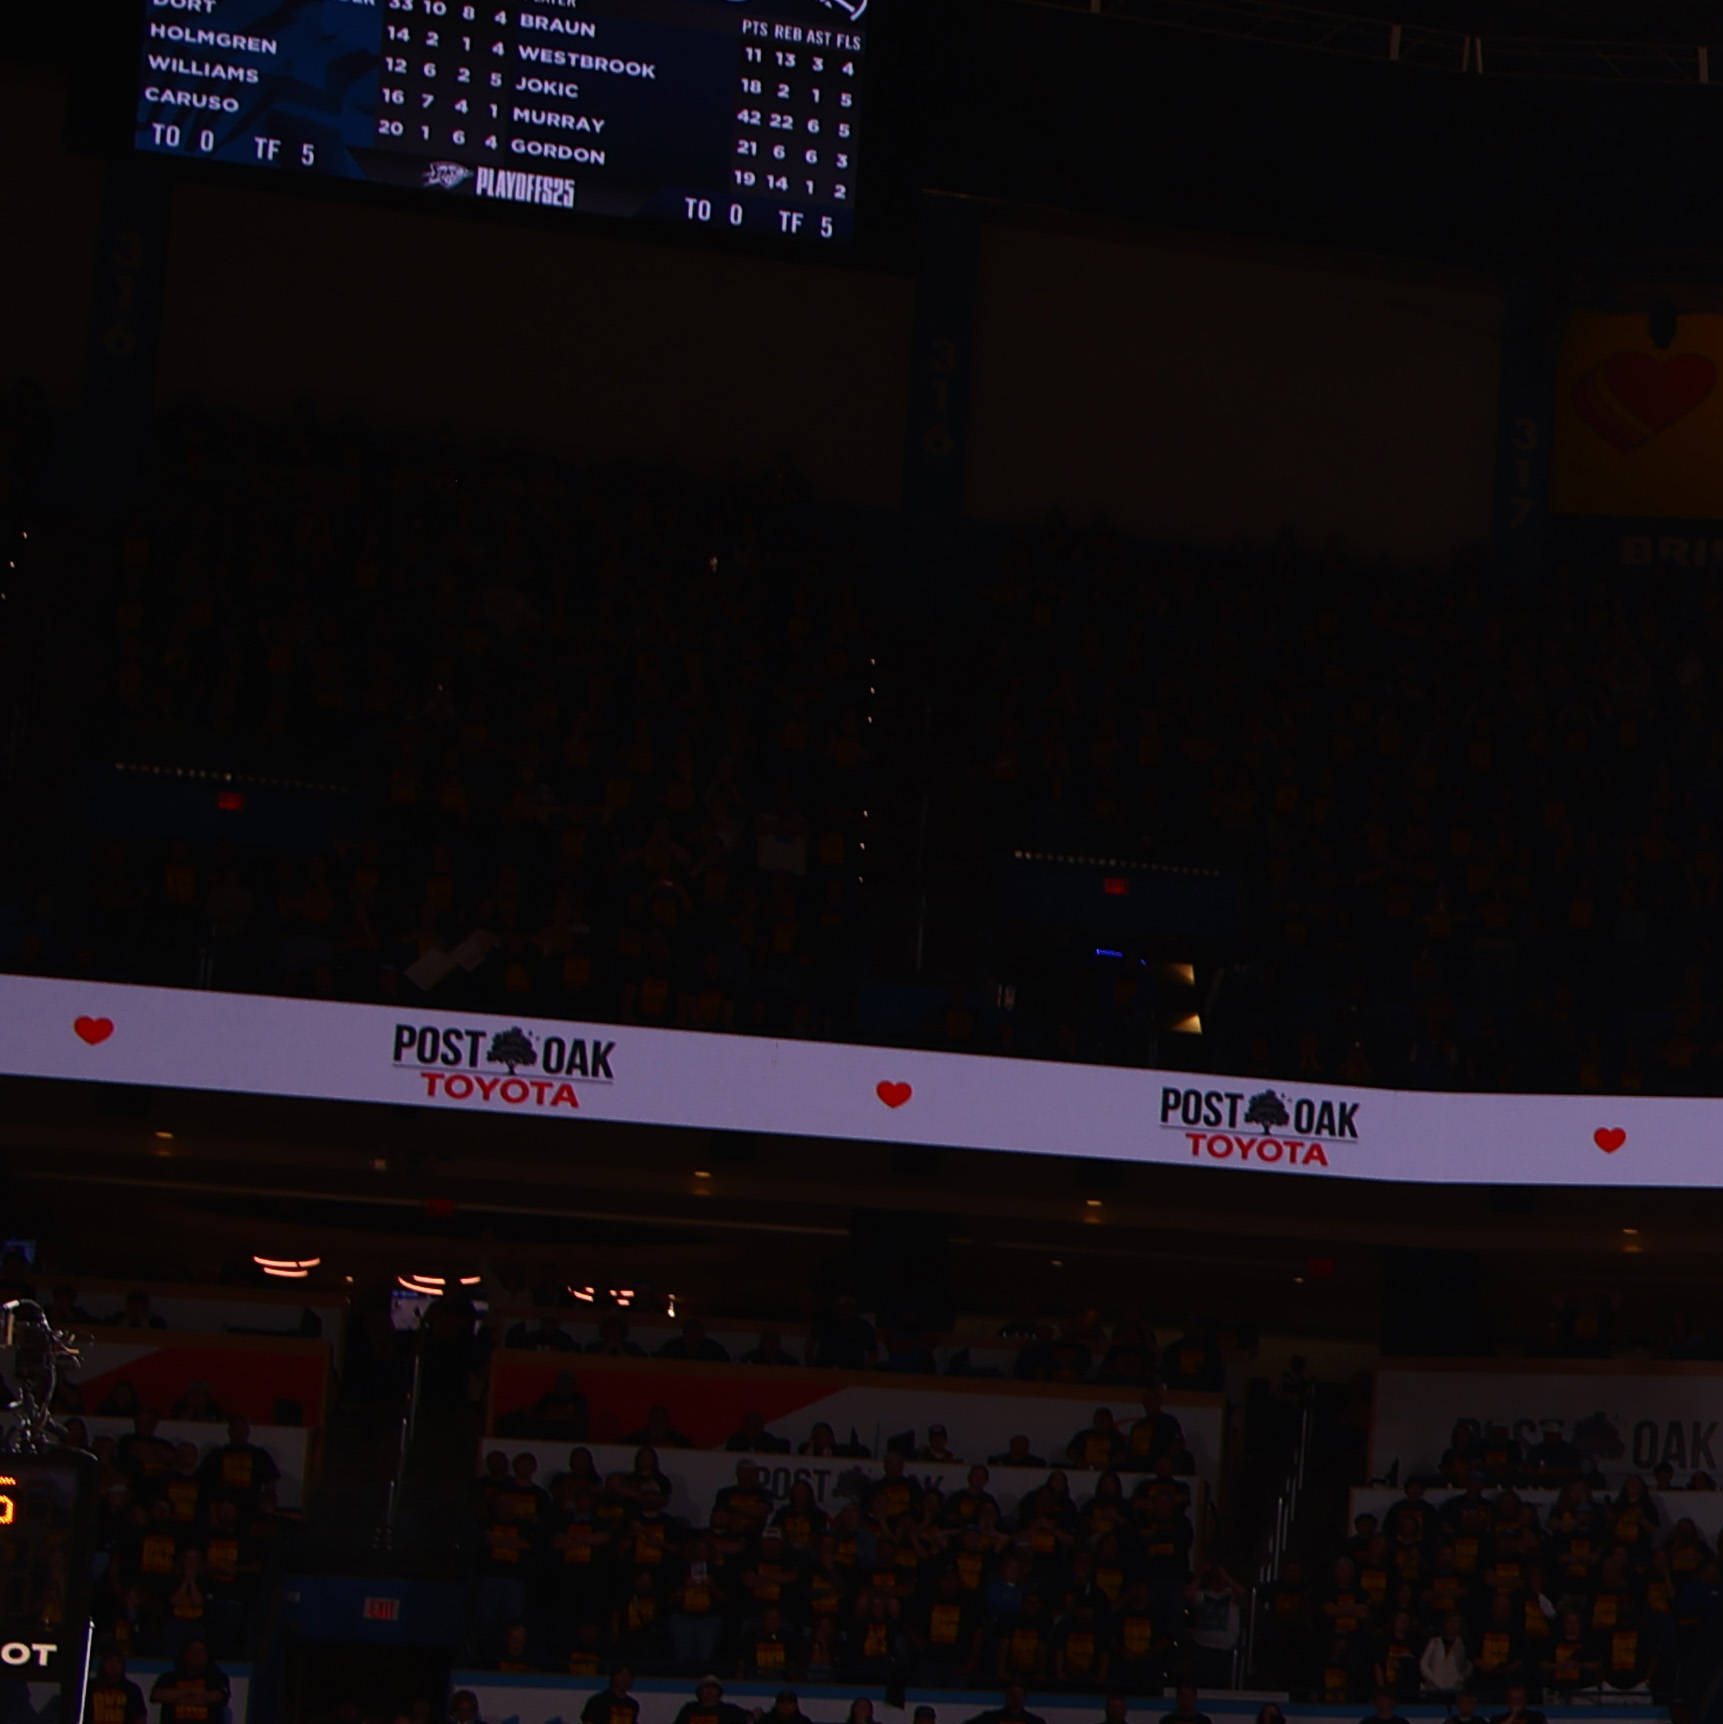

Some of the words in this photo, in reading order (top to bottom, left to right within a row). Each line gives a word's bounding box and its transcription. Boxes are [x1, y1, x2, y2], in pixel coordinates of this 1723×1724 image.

[424, 1, 447, 15] 10
[462, 6, 475, 20] 8
[494, 10, 507, 25] 4
[742, 19, 768, 37] PTS
[774, 24, 802, 42] REB
[807, 29, 831, 47] AST
[837, 34, 861, 50] FLS
[150, 23, 277, 54] HOLMGREN
[385, 56, 407, 74] 12
[424, 62, 436, 77] 6
[457, 68, 470, 83] 2
[490, 73, 502, 87] 5
[387, 25, 410, 42] 14
[425, 31, 438, 47] 2
[462, 37, 471, 51] 1
[492, 41, 505, 56] 4
[520, 13, 596, 38] BRAUN
[745, 47, 762, 63] 11
[776, 52, 796, 68] 13
[812, 57, 824, 72] 3
[842, 62, 854, 76] 4
[148, 54, 259, 84] WILLIAMS
[382, 88, 404, 104] 16
[422, 94, 434, 109] 7
[455, 99, 468, 114] 4
[490, 103, 498, 119] 1
[518, 45, 656, 79] WESTBROOK
[741, 78, 762, 94] 18
[777, 84, 789, 99] 2
[812, 88, 820, 103] 1
[841, 93, 852, 107] 5
[145, 87, 239, 112] CARUSO
[378, 119, 404, 136] 20
[422, 125, 429, 141] 1
[453, 131, 465, 145] 6
[485, 135, 498, 150] 4
[515, 77, 579, 98] JOKIC
[737, 109, 761, 126] 42
[769, 113, 793, 130] 22
[808, 119, 819, 133] 6
[839, 123, 850, 138] 5
[152, 123, 180, 147] TO
[255, 137, 281, 161] TF
[301, 144, 314, 166] 5
[513, 107, 605, 134] MURRAY
[737, 139, 757, 156] 21
[774, 144, 785, 159] 6
[806, 149, 817, 164] 6
[836, 153, 848, 168] 3
[511, 138, 605, 165] GORDON
[735, 170, 755, 186] 19
[767, 174, 788, 191] 14
[806, 180, 813, 194] 1
[834, 184, 846, 199] 2
[685, 197, 711, 221] TO
[779, 210, 804, 233] TF
[821, 216, 833, 238] 5
[394, 1025, 486, 1067] POST
[541, 1037, 615, 1080] OAK
[421, 1072, 579, 1109] TOYOTA
[1160, 1087, 1246, 1129] POST
[1295, 1101, 1361, 1139] OAK
[1185, 1132, 1330, 1168] TOYOTA
[1633, 1419, 1719, 1469] OAK
